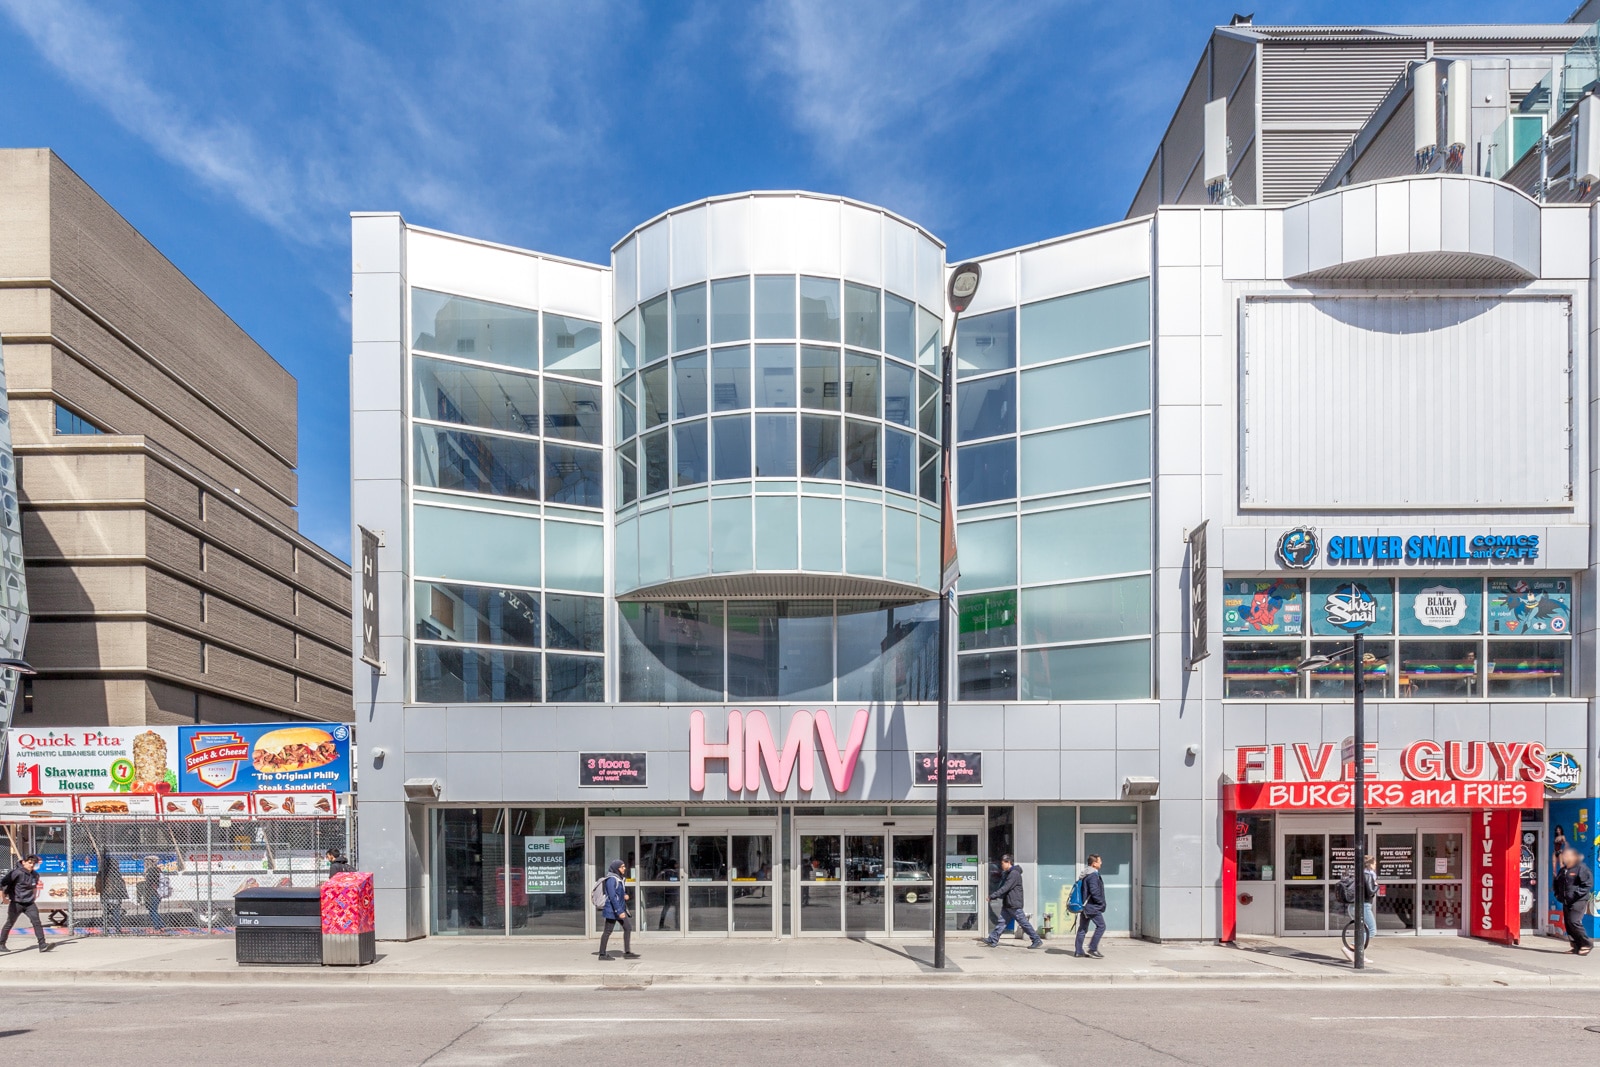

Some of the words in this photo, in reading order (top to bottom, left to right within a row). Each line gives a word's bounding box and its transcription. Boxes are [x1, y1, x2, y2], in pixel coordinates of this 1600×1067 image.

[1329, 535, 1403, 560] SILVER
[1408, 535, 1471, 560] SNAIL
[1473, 535, 1539, 547] COMICS
[1473, 548, 1493, 558] and
[364, 555, 374, 643] HMV
[1192, 550, 1202, 639] HMV
[1327, 583, 1375, 612] Silver
[1427, 596, 1452, 606] BLACK
[1324, 603, 1377, 624] Snail
[1425, 606, 1455, 616] CANARY
[18, 732, 76, 750] Quick
[83, 731, 122, 747] Pita
[187, 752, 209, 767] Steak
[209, 750, 218, 759] &
[218, 747, 247, 757] Cheese
[690, 709, 869, 793] HMV
[587, 759, 596, 769] 3
[598, 758, 631, 769] floors
[923, 758, 931, 768] 3
[933, 757, 966, 768] fors
[1235, 742, 1380, 783] FIVE
[1400, 740, 1546, 783] GUYS
[16, 762, 43, 795] #1
[44, 767, 108, 778] Shawarma
[275, 772, 312, 782] Original
[314, 771, 340, 781] Philly
[58, 779, 95, 791] House
[1410, 785, 1457, 806] and
[1463, 784, 1528, 805] FRIES
[1236, 824, 1250, 834] EN
[1482, 811, 1494, 867] FIVE
[1481, 873, 1494, 930] GUYS
[239, 917, 253, 925] Litter
